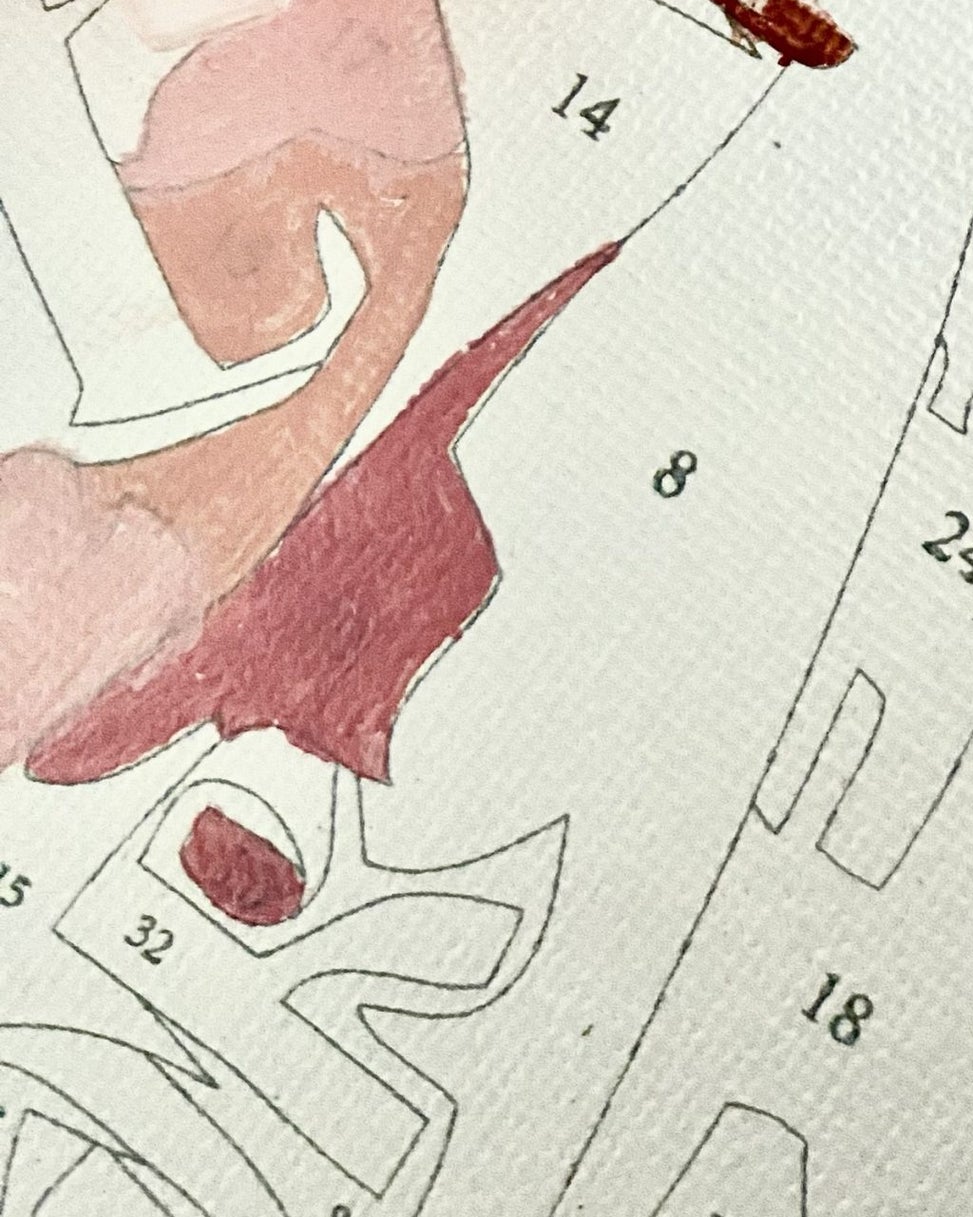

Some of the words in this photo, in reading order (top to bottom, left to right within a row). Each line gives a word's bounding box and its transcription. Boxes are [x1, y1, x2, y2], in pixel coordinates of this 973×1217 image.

[552, 73, 620, 141] 14
[653, 450, 697, 498] 8
[124, 915, 173, 965] 32
[802, 973, 873, 1046] 18
